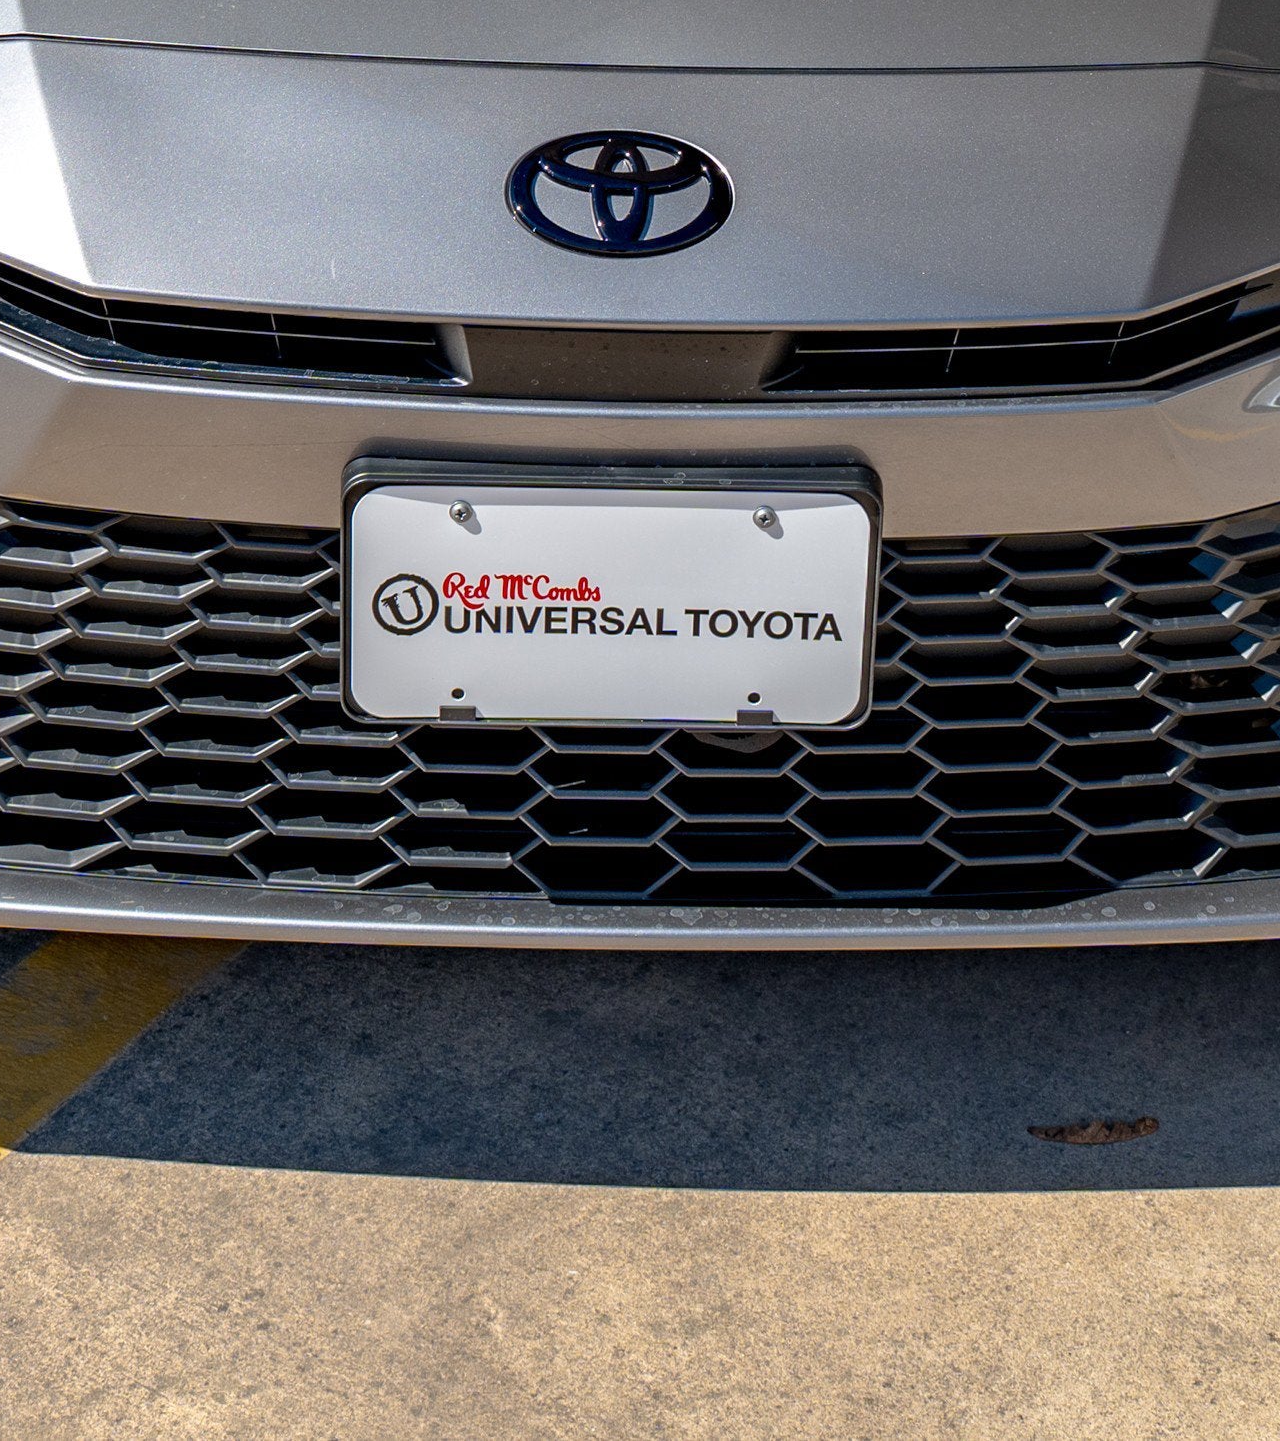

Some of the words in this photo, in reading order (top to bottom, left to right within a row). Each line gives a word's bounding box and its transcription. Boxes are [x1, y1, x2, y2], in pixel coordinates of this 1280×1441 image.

[442, 572, 491, 610] Red
[494, 574, 602, 602] McCombs
[444, 605, 678, 637] UNIVERSAL
[684, 608, 843, 642] TOYOTA
